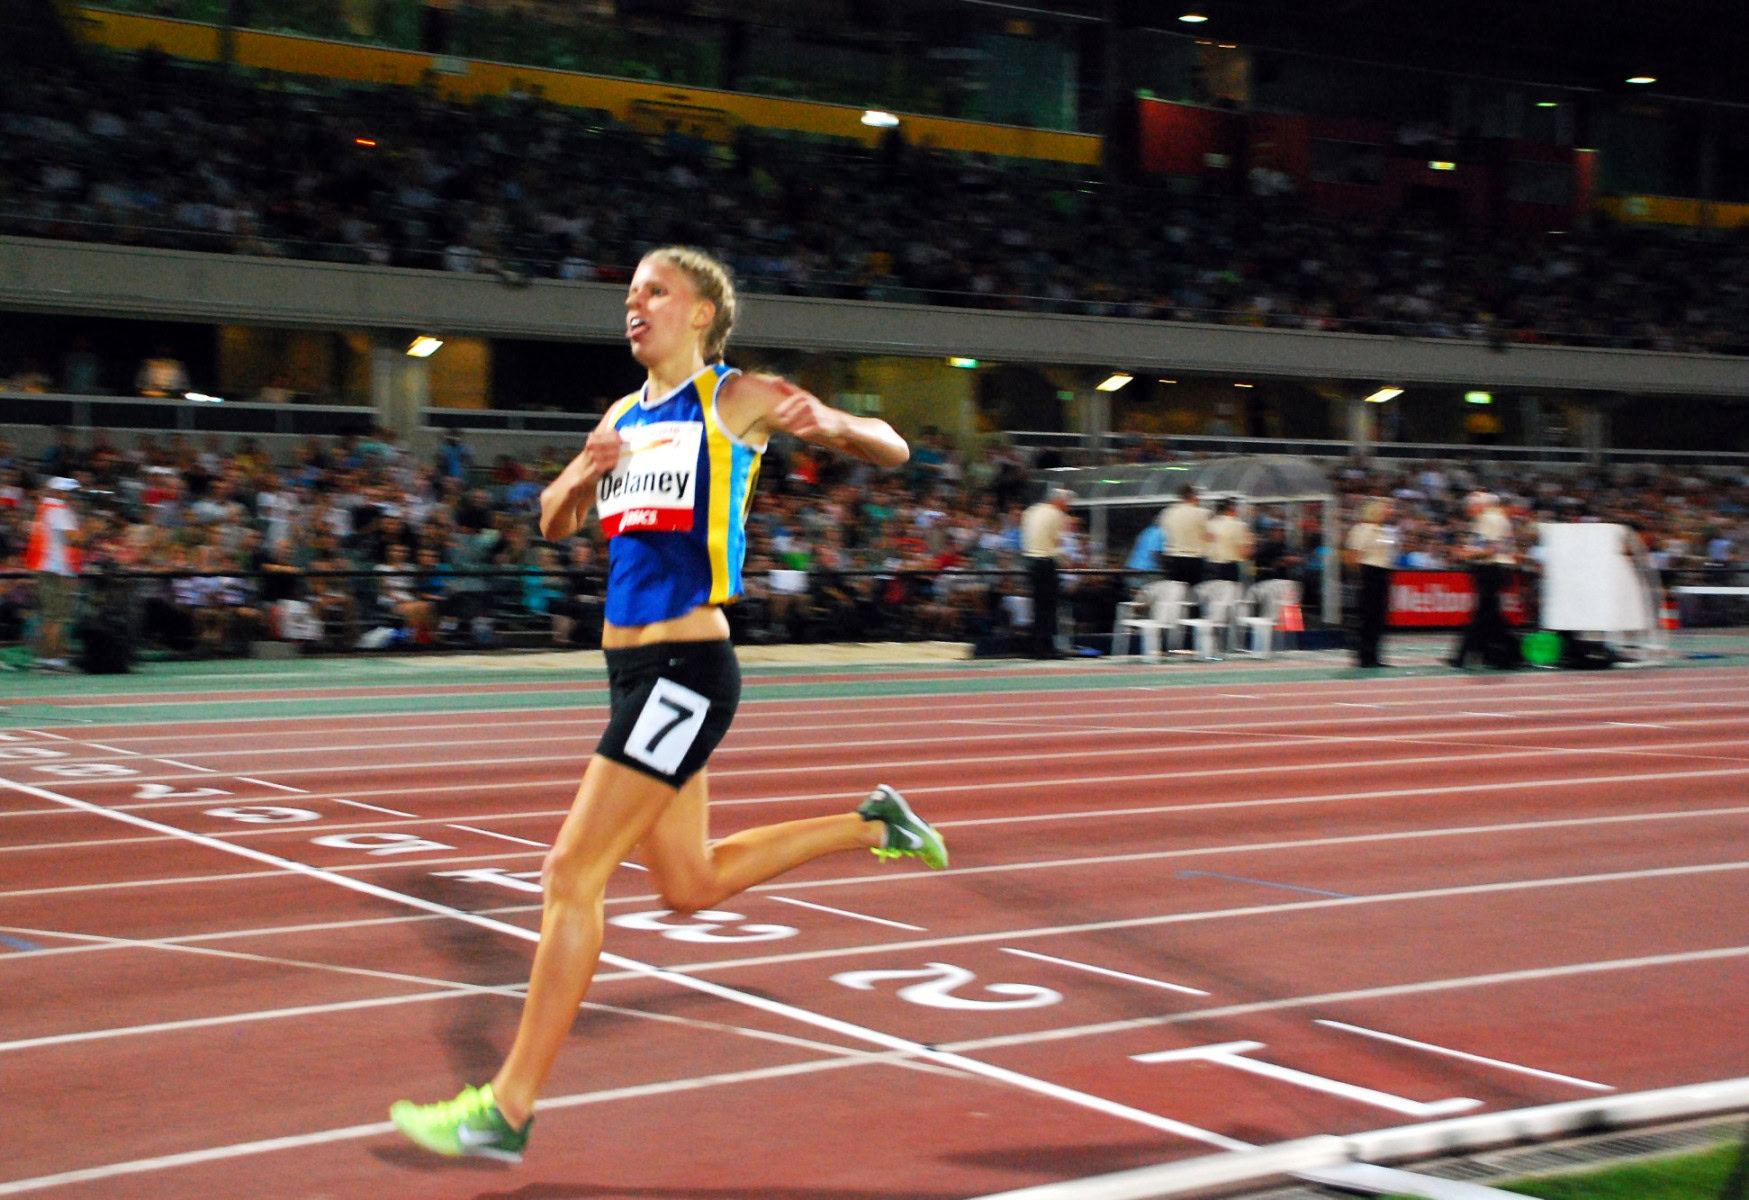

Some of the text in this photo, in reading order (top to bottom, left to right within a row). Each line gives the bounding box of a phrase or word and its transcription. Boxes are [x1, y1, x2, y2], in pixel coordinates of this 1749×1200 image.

[600, 470, 690, 502] Delaney
[645, 695, 694, 754] 7
[132, 783, 235, 799] 7
[202, 806, 323, 823] 6
[310, 832, 458, 855] 5
[608, 910, 800, 943] 3
[829, 962, 1063, 1010] 2
[1128, 1040, 1485, 1116] 1
